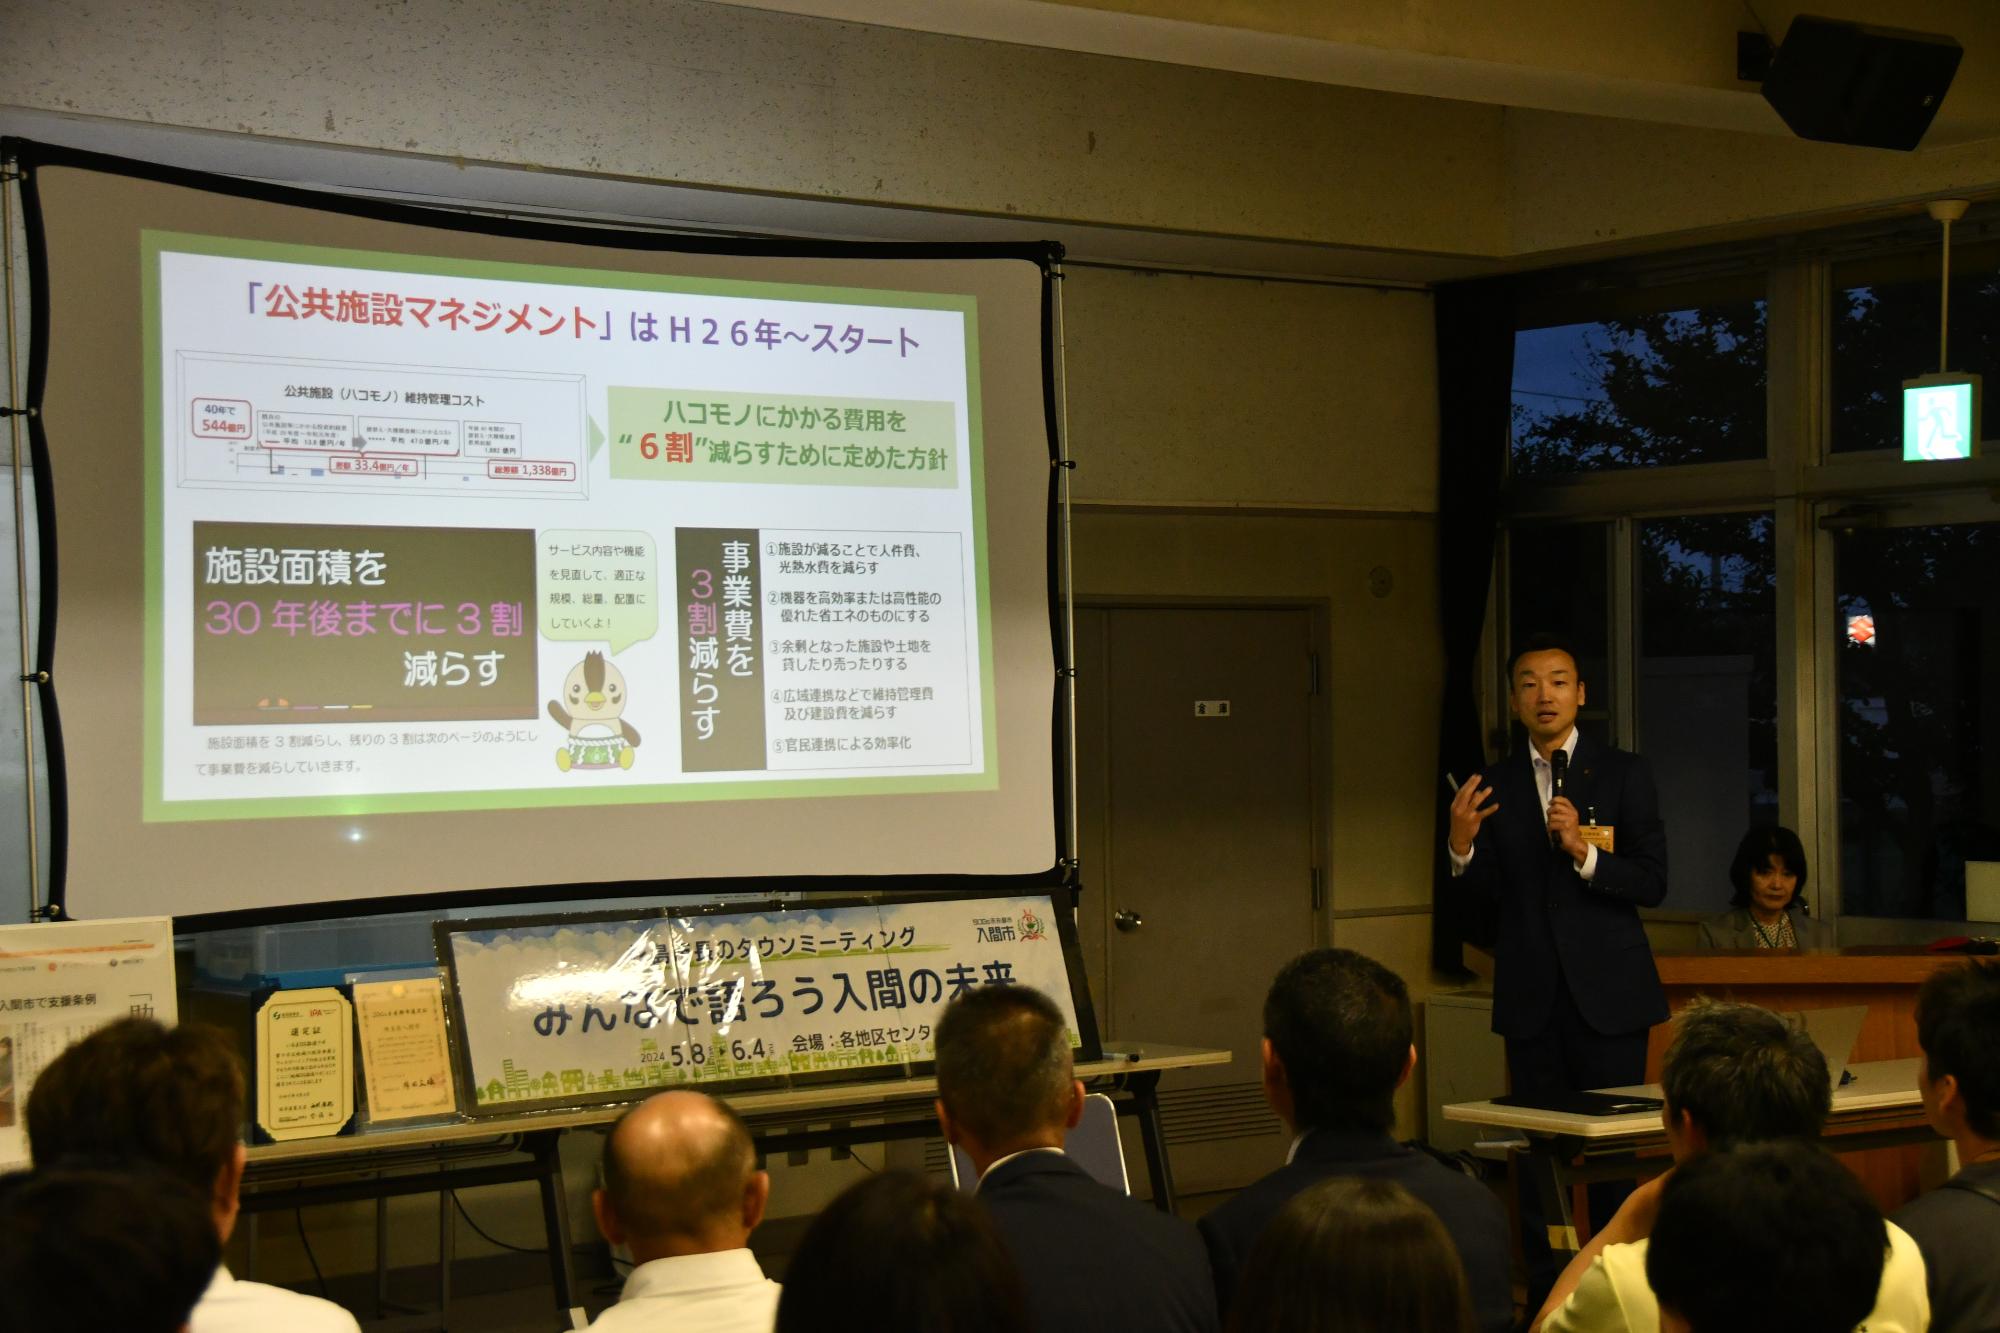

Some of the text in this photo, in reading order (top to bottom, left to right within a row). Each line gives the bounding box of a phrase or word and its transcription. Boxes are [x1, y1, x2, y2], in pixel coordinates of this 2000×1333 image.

[204, 404, 236, 416] 40年で
[663, 400, 907, 432] ハコモノにかかる費用を
[202, 419, 246, 433] 544億円
[548, 544, 645, 557] サービス内容や機能
[205, 546, 387, 585] 施設面積を
[779, 560, 879, 575] 光熱水費を減らす
[550, 568, 645, 581] を見直して、適正な
[768, 590, 942, 606] ②機器を高効率または高性能の
[721, 540, 754, 677] 事業費を
[781, 608, 930, 623] 優れた省エネのものにする
[687, 568, 721, 741] 3割減らす
[769, 639, 932, 655] ③余剰となった施設や土地を
[403, 650, 505, 686] 減らす
[782, 657, 908, 672] 貸したり売ったりする
[784, 705, 897, 721] 及び建設費を減らす
[773, 735, 912, 754] ⑤官民連携による効率化
[195, 760, 361, 776] て事業費を減らしていきます。
[977, 925, 1016, 943] 入間市
[641, 1051, 665, 1063] 2024
[671, 1043, 706, 1067] 5.8
[732, 1037, 765, 1061] 6.4
